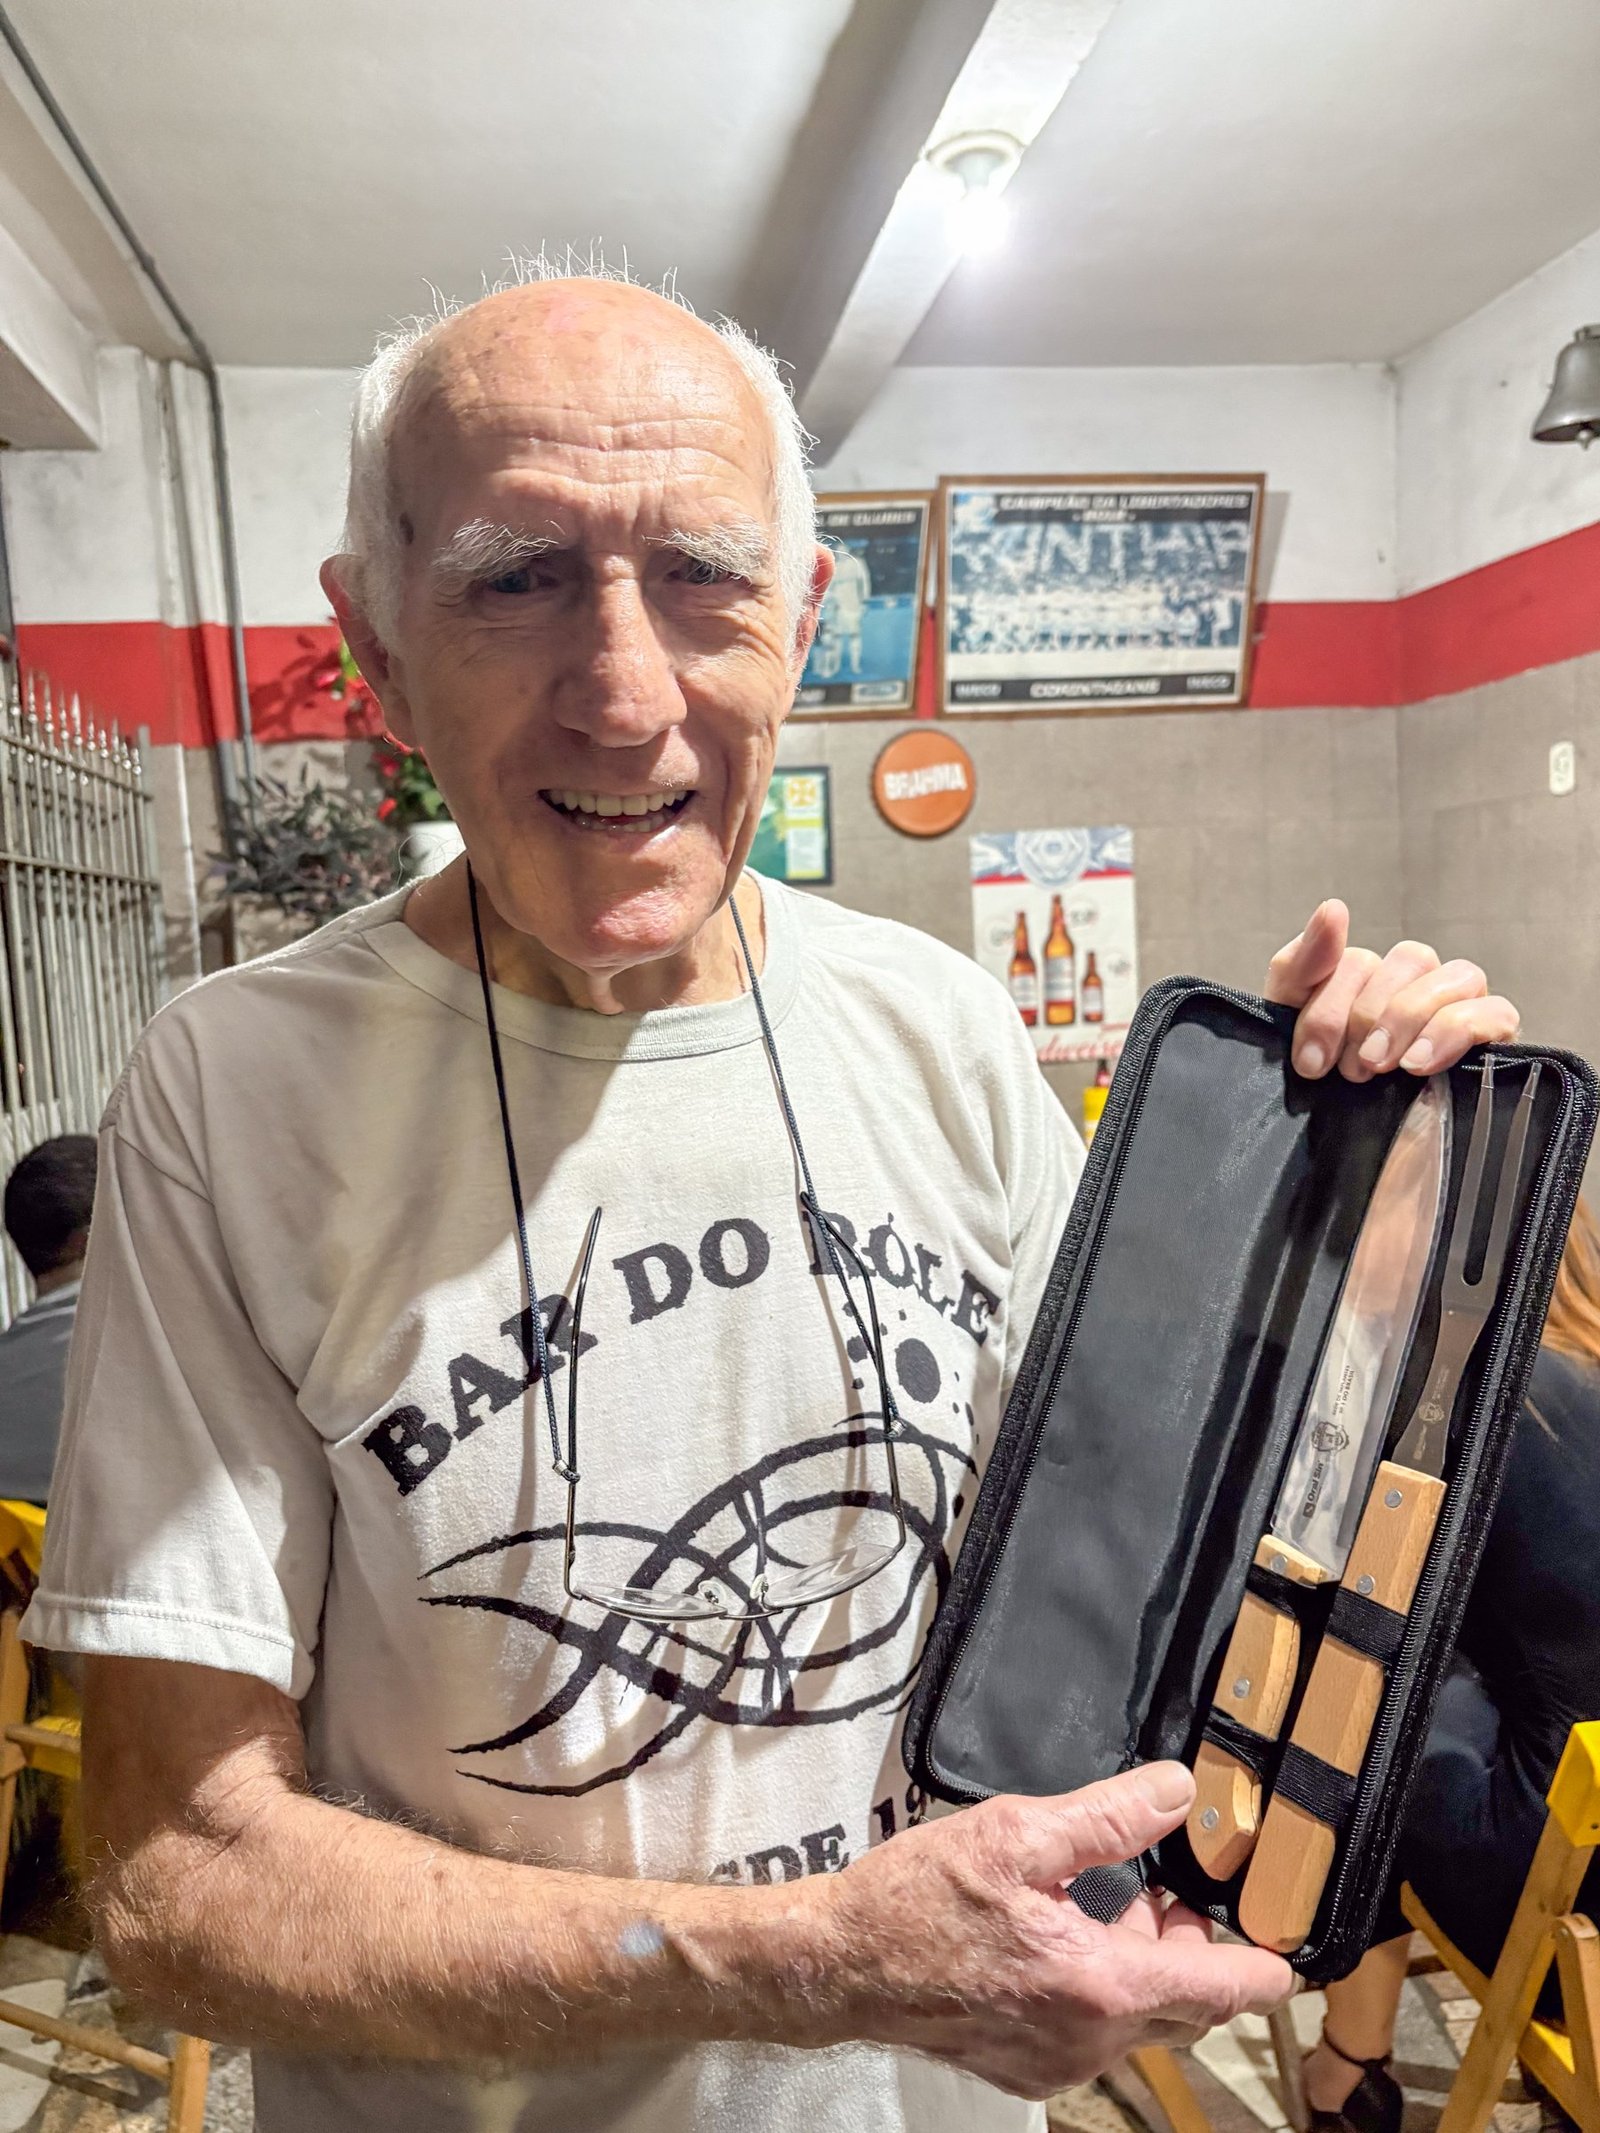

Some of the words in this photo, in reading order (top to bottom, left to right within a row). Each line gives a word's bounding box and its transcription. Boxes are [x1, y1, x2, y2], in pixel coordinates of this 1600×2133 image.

[884, 763, 968, 801] BRAHMA
[363, 1294, 598, 1497] BAR
[612, 1217, 771, 1325] DO
[1344, 1369, 1354, 1390] BRASIL
[1312, 1461, 1324, 1479] Sin
[1307, 1479, 1319, 1502] Oral
